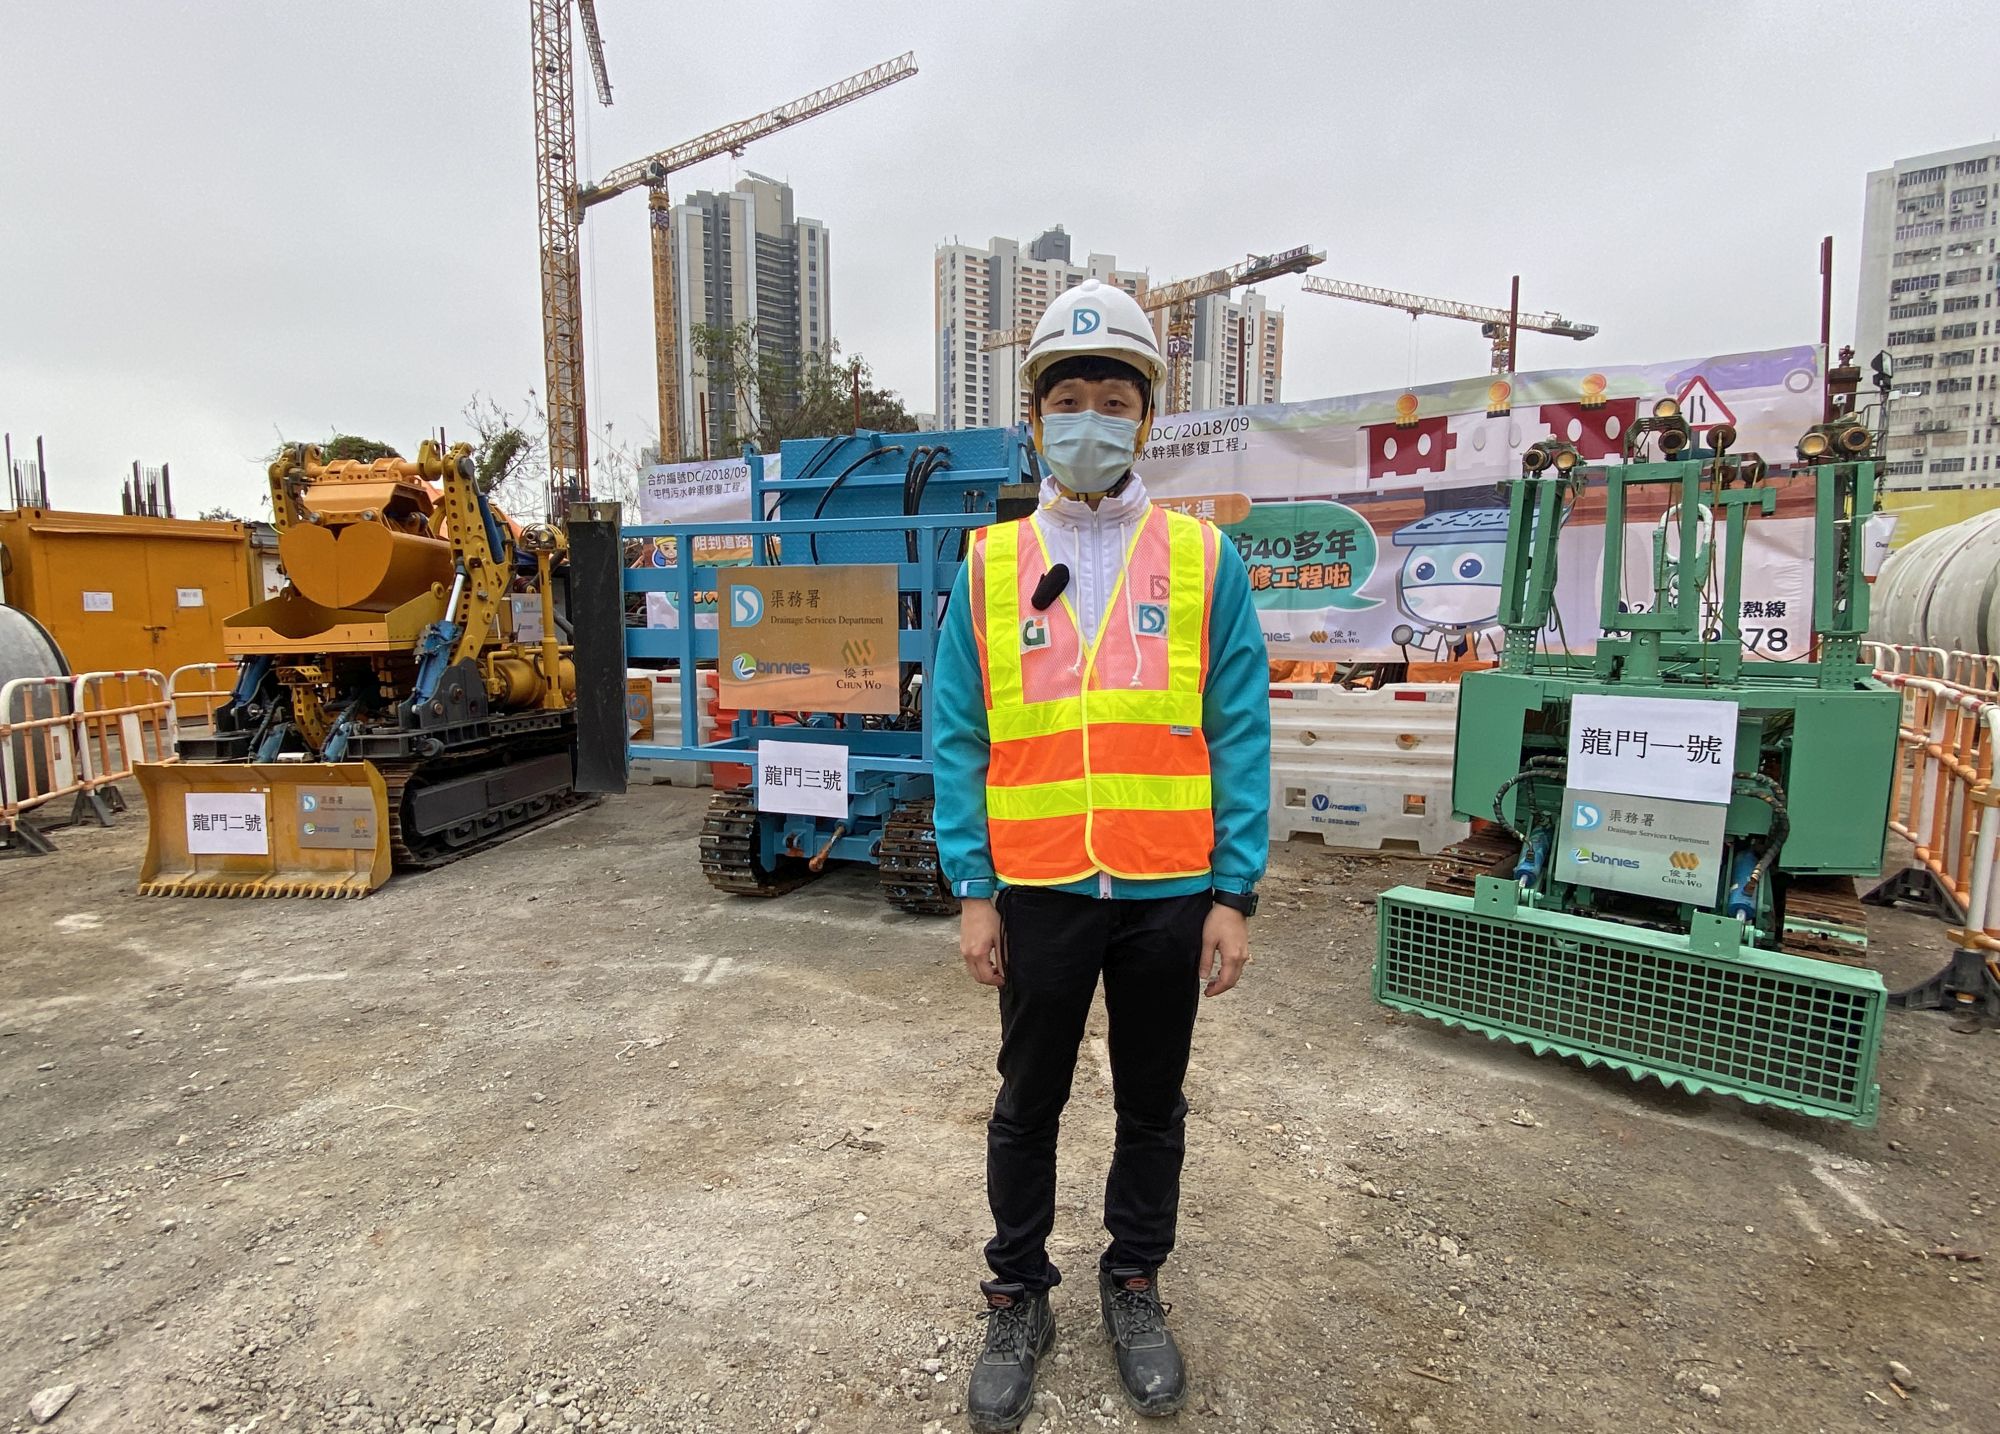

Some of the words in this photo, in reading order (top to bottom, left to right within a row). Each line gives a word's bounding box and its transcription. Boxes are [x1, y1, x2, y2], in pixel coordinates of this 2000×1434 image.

[1150, 416, 1250, 442] DC/2018/09
[770, 589, 821, 608] 渠務署
[770, 615, 803, 625] Drainage
[805, 615, 837, 625] Services
[838, 615, 884, 626] Department
[757, 658, 811, 675] binnies
[843, 668, 874, 679] 俊和
[1579, 727, 1723, 765] 龍門一號
[764, 765, 842, 791] 龍門三號
[192, 814, 262, 832] 龍門二號
[1608, 809, 1655, 827] 渠務署
[1607, 825, 1637, 836] Drainage
[1639, 829, 1668, 840] Services
[1669, 834, 1710, 846] Department
[1591, 851, 1640, 869] binnies
